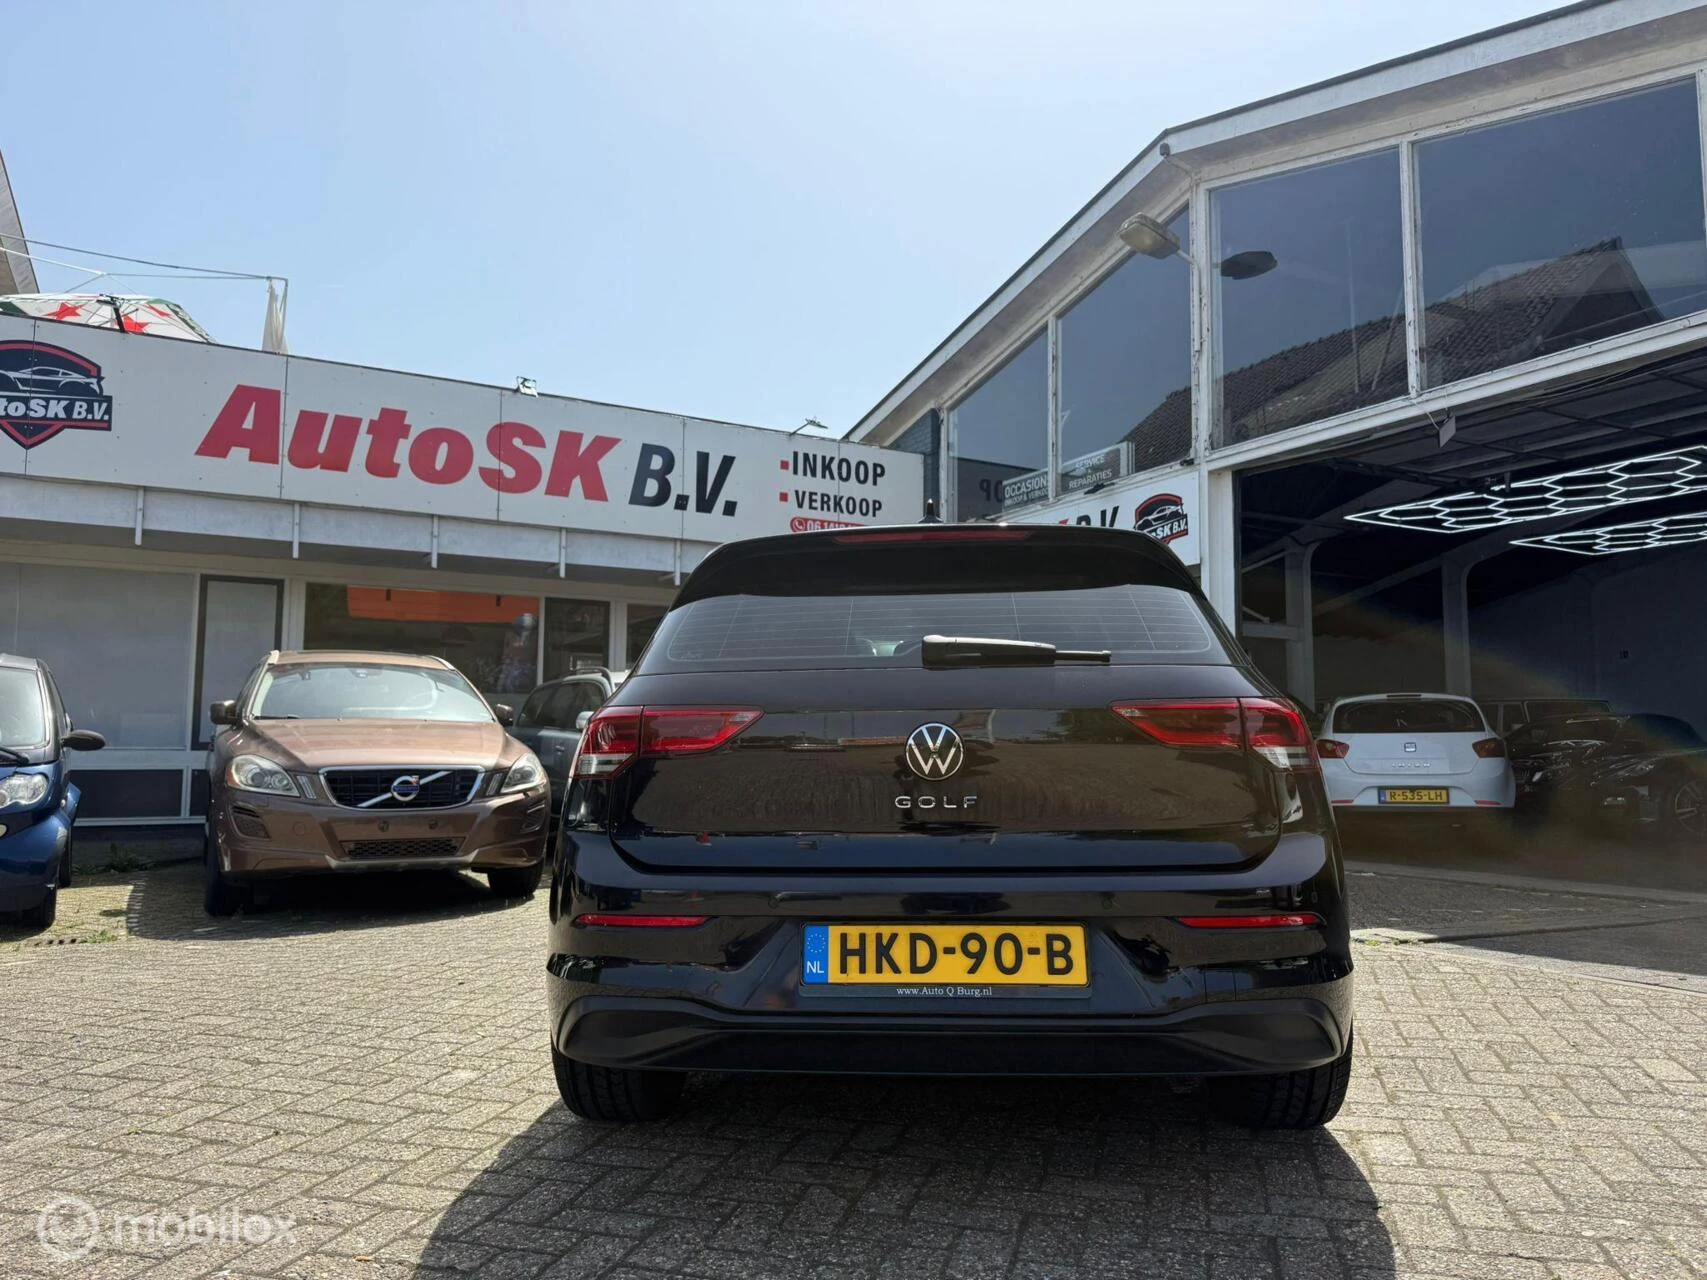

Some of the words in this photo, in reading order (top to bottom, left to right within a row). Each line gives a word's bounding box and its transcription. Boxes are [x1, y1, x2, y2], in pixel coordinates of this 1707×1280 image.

[72, 401, 110, 421] B.V.
[195, 384, 622, 502] AutoSK
[628, 443, 737, 517] B.V.
[793, 450, 886, 486] INKOOP
[1069, 469, 1113, 489] REPARATIES
[795, 489, 882, 518] VERKOOP
[894, 795, 978, 809] GOLF
[1389, 791, 1443, 801] R-535-LH
[839, 932, 1074, 976] HKD-90-B
[806, 960, 825, 974] NL
[896, 986, 944, 996] www.Auto
[946, 986, 955, 997] Q
[957, 986, 993, 997] Burg.nl
